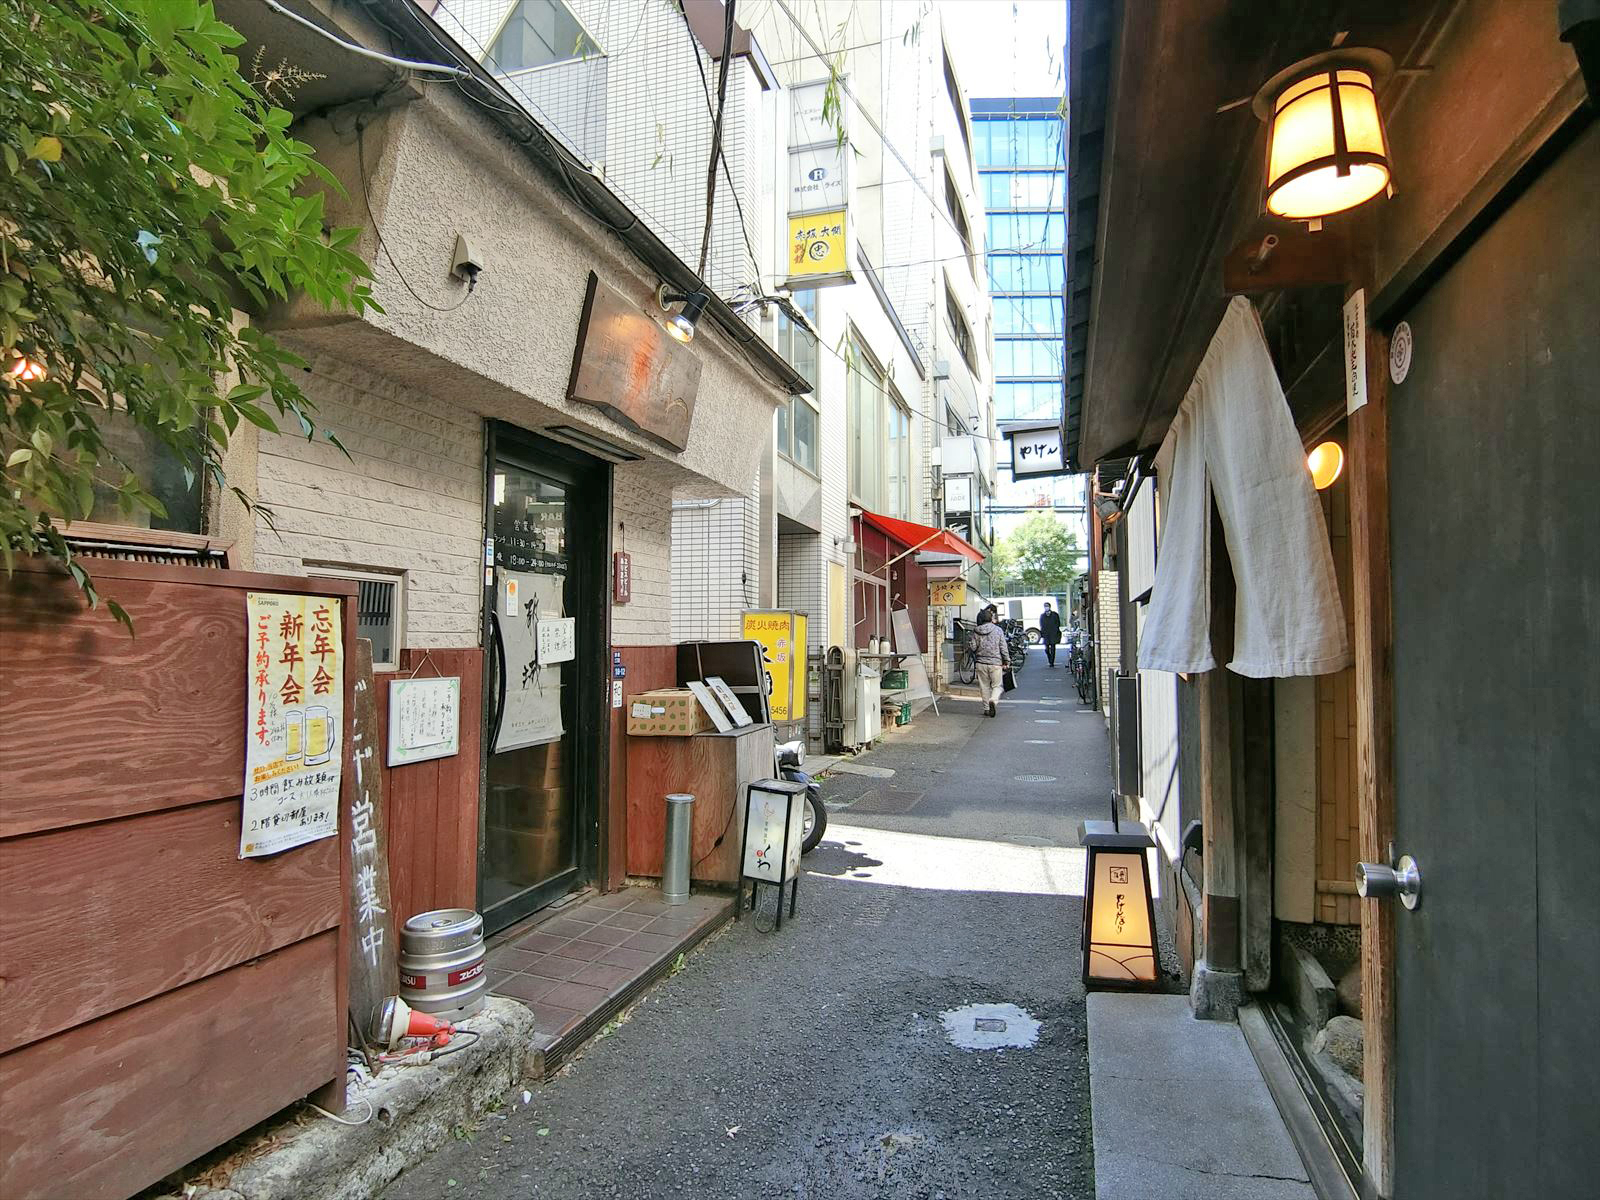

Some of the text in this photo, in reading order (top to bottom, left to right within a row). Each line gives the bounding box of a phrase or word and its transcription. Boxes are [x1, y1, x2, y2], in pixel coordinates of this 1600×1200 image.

[255, 614, 272, 747] ご予約承ります。
[279, 610, 304, 705] 新年会
[310, 605, 335, 695] 忘年会
[777, 640, 786, 662] 赤坂
